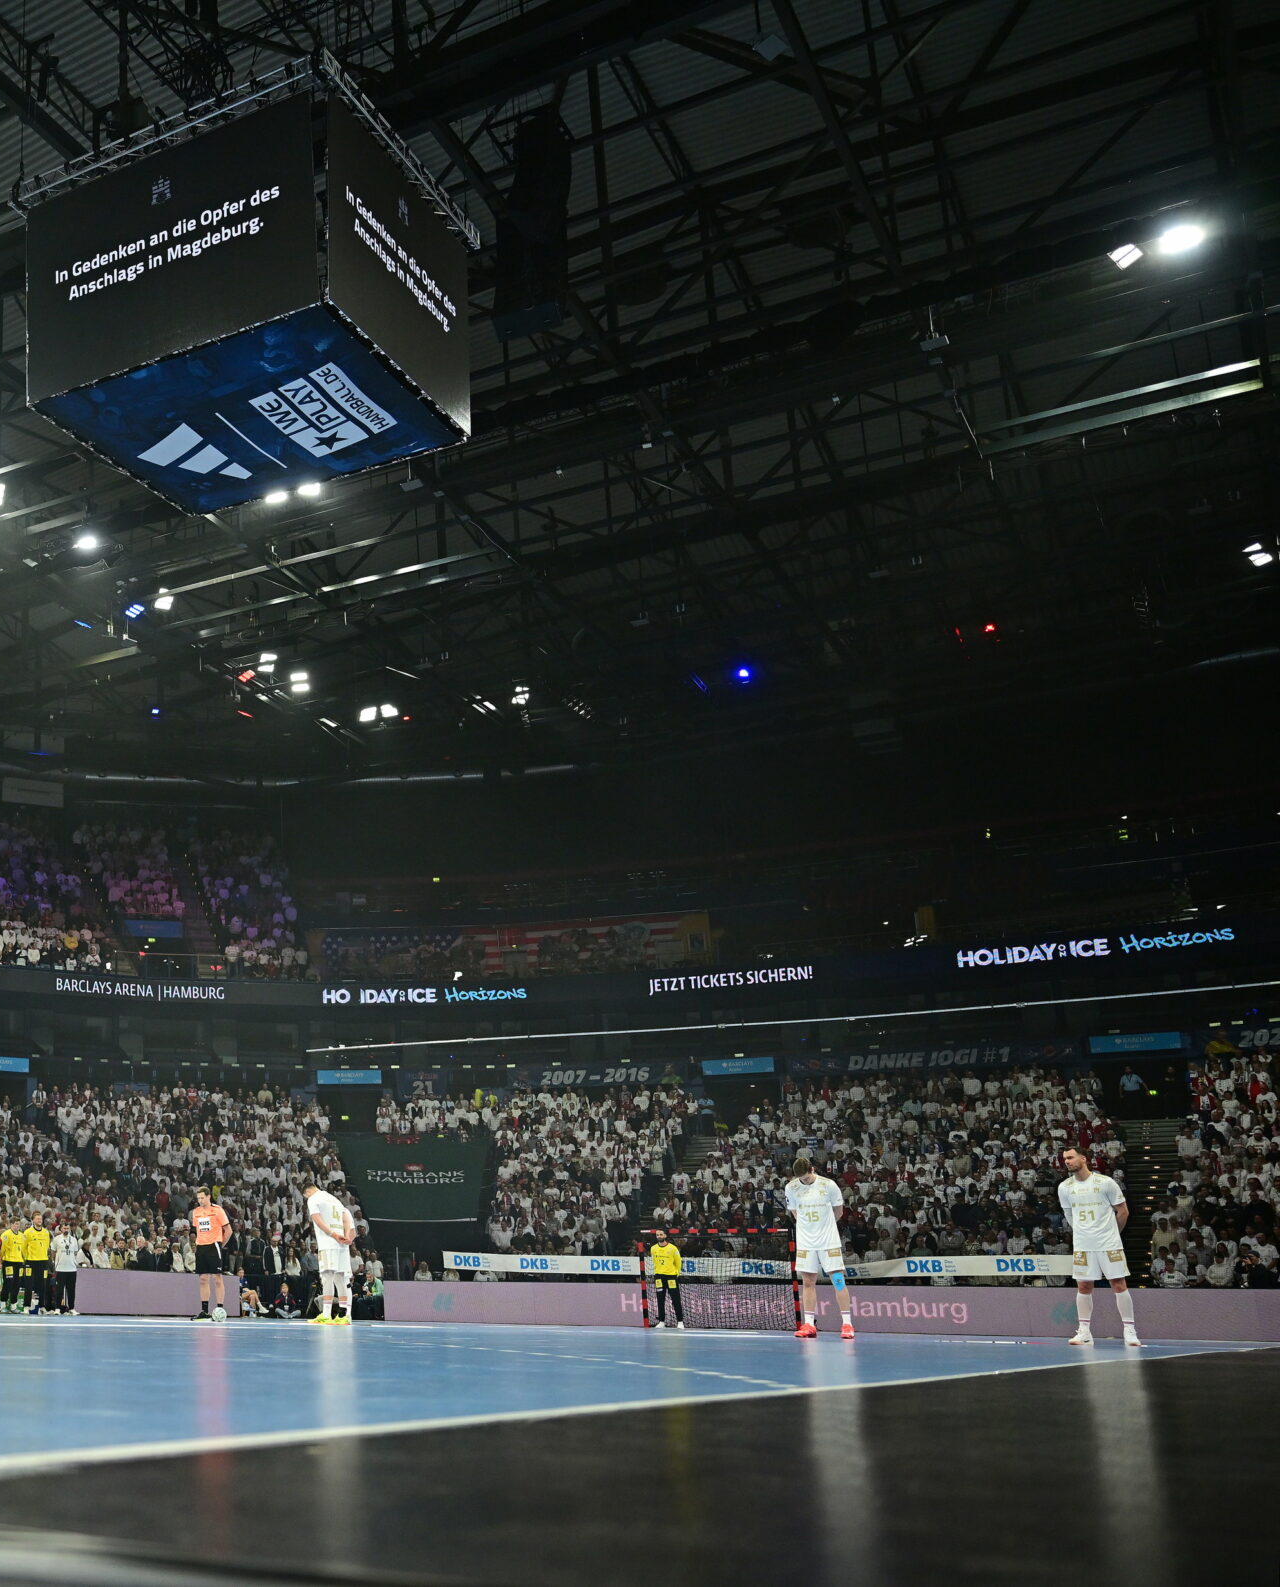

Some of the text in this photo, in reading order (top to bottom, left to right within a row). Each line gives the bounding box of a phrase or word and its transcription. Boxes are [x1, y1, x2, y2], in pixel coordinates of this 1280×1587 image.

[55, 185, 280, 284] In Gedenken an die Opfer des
[69, 216, 264, 300] Anschlags in Magdeburg.
[346, 185, 456, 317] In Gedenken an die Opfer des
[354, 218, 450, 333] Anschlags in Magdeburg.
[284, 384, 340, 427] PLAY
[316, 367, 390, 430] HANDBALL.DE
[258, 398, 299, 430] WE
[957, 943, 1057, 968] HOLIDAY
[1070, 938, 1112, 958] ICE
[56, 978, 112, 994] BARCLAYS
[114, 983, 153, 997] ARENA
[164, 986, 225, 1000] HAMBURG
[649, 965, 813, 996] JETZT TICKETS SICHERN!
[323, 988, 399, 1004] HOIDAY
[408, 988, 438, 1003] ICE
[1238, 1028, 1280, 1047] 202
[848, 1052, 925, 1071] DANKE
[928, 1048, 977, 1067] JOGI
[983, 1046, 1010, 1063] #1
[540, 1070, 587, 1086] 2007
[604, 1067, 650, 1084] 2016
[412, 1081, 433, 1095] 21
[366, 1169, 465, 1177] SPIELBANK
[367, 1176, 464, 1184] HAMBURG
[332, 1205, 340, 1221] 4
[805, 1211, 820, 1222] 15
[1079, 1210, 1096, 1221] 51
[453, 1255, 481, 1267] DKB
[520, 1258, 549, 1270] DKB
[590, 1259, 620, 1272] DKB
[741, 1261, 775, 1275] DKB
[906, 1260, 942, 1273] DKB
[996, 1259, 1035, 1272] DKB
